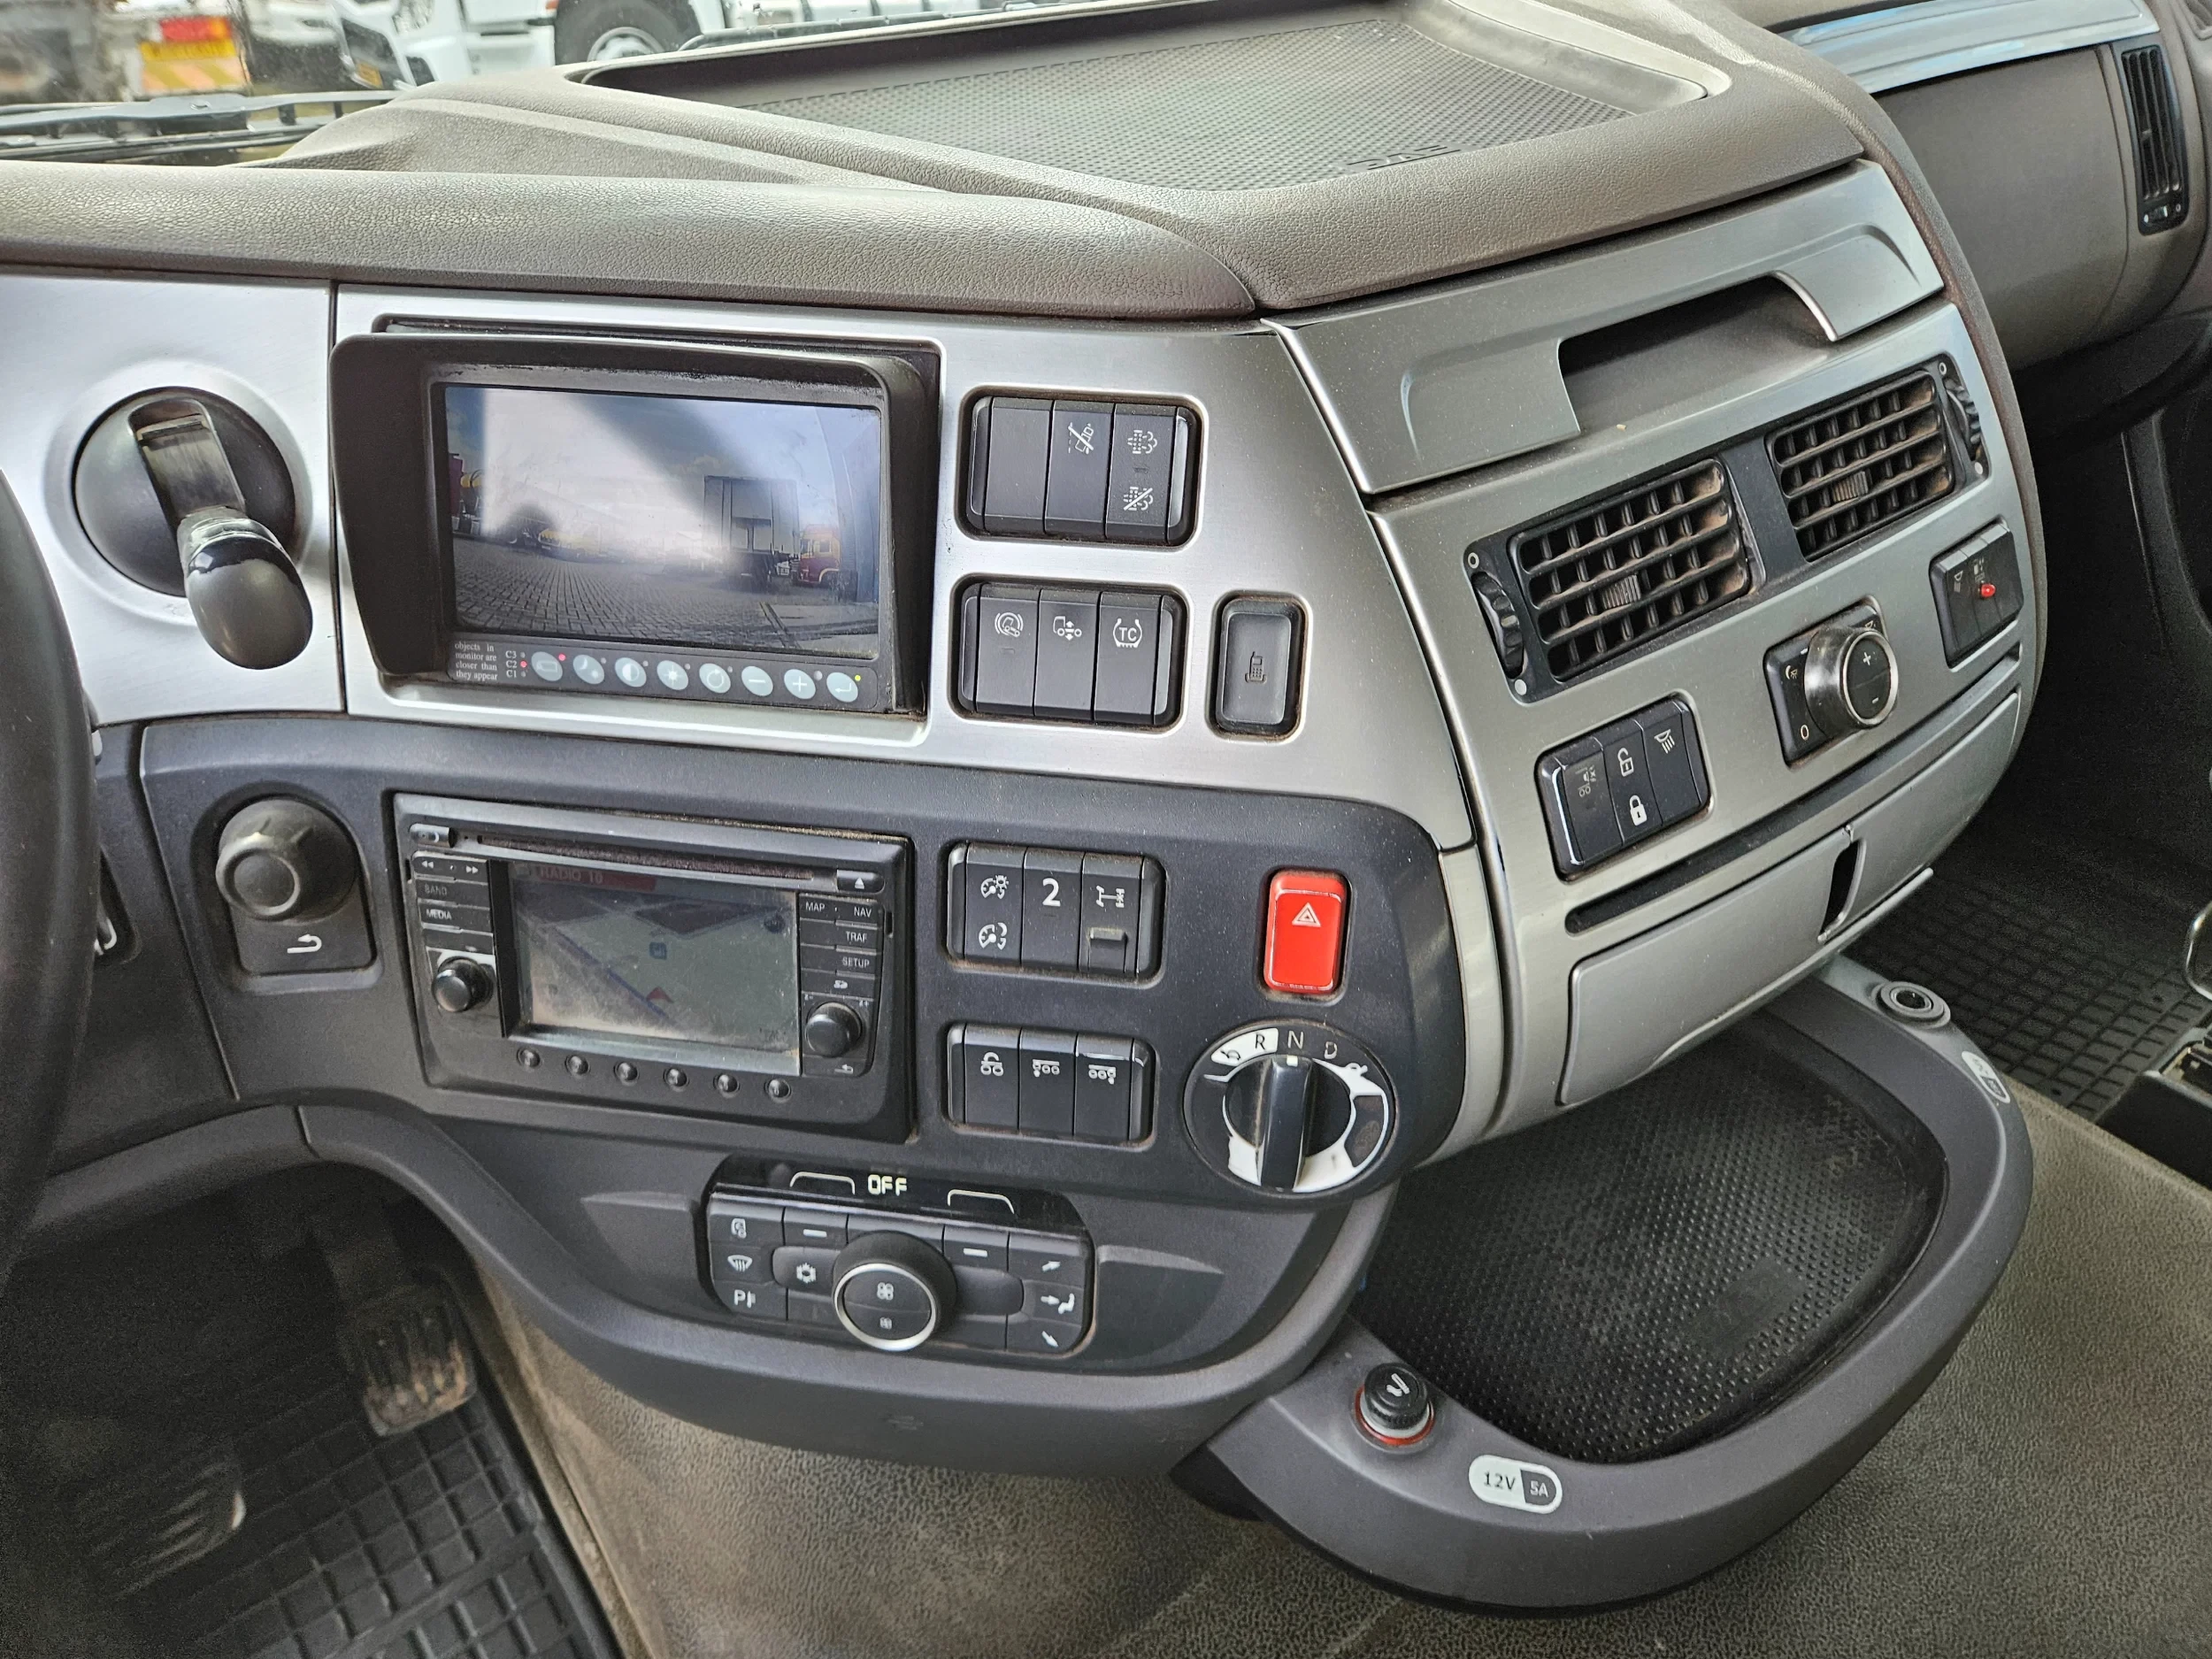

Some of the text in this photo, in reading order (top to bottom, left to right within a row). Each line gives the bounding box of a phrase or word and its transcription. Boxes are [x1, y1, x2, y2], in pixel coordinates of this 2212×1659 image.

[1118, 626, 1137, 641] TC
[454, 641, 495, 652] objects in
[455, 651, 484, 661] monitor
[505, 649, 518, 659] C3
[456, 660, 497, 671] closer than
[505, 659, 518, 669] C2
[456, 669, 498, 682] they appear
[506, 670, 517, 679] C1
[1042, 877, 1061, 907] 2
[805, 901, 826, 912] MAP
[854, 906, 872, 918] NAV
[426, 908, 452, 920] MEDIA
[845, 931, 868, 943] TRAF
[841, 956, 870, 969] SETUP
[1255, 1033, 1266, 1051] R
[1287, 1030, 1305, 1049] N
[1324, 1041, 1338, 1060] D
[867, 1174, 908, 1196] OFF
[1484, 1469, 1549, 1498] 12V 5A
